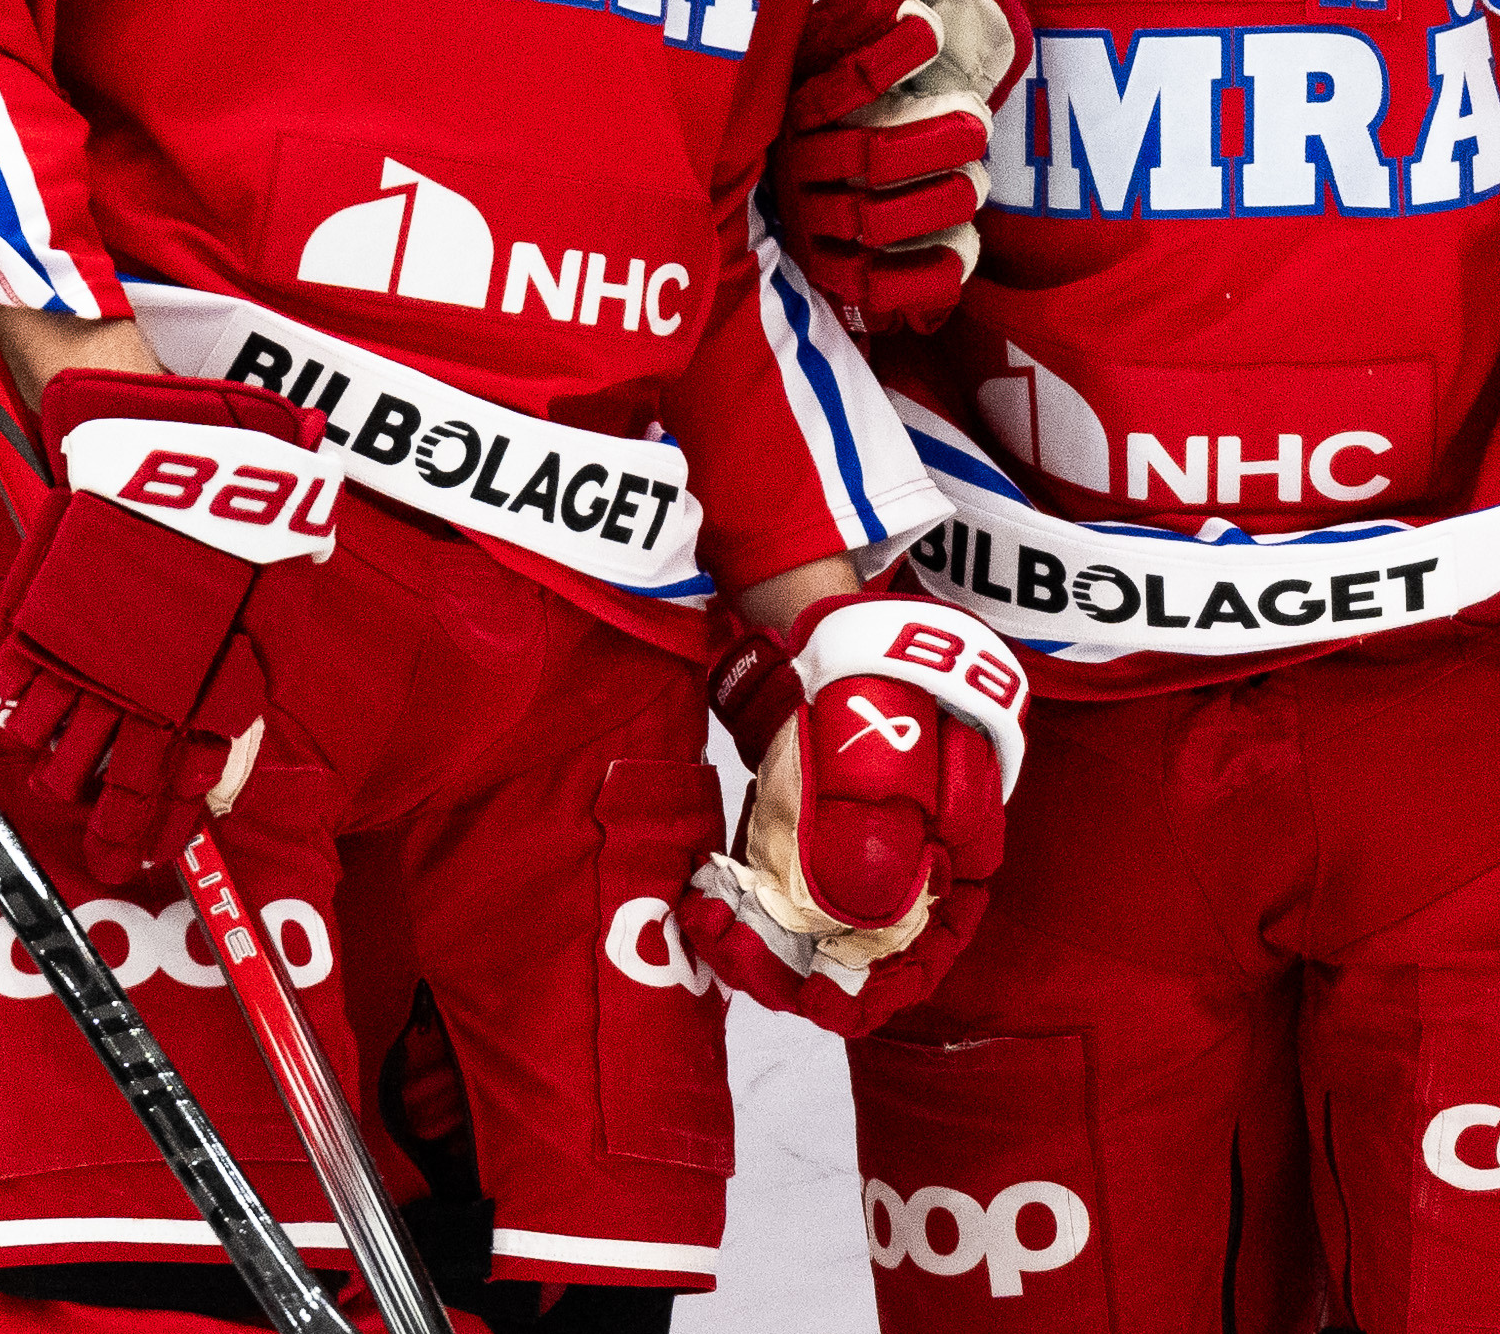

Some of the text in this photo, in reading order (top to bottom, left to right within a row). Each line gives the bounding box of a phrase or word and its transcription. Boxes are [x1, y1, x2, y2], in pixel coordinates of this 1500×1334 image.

[501, 240, 691, 338] NHC
[224, 330, 678, 553] BILBOLAGET
[1127, 431, 1394, 506] NHC
[909, 517, 1439, 632] BILBOLAGET
[865, 1179, 1091, 1299] oop
